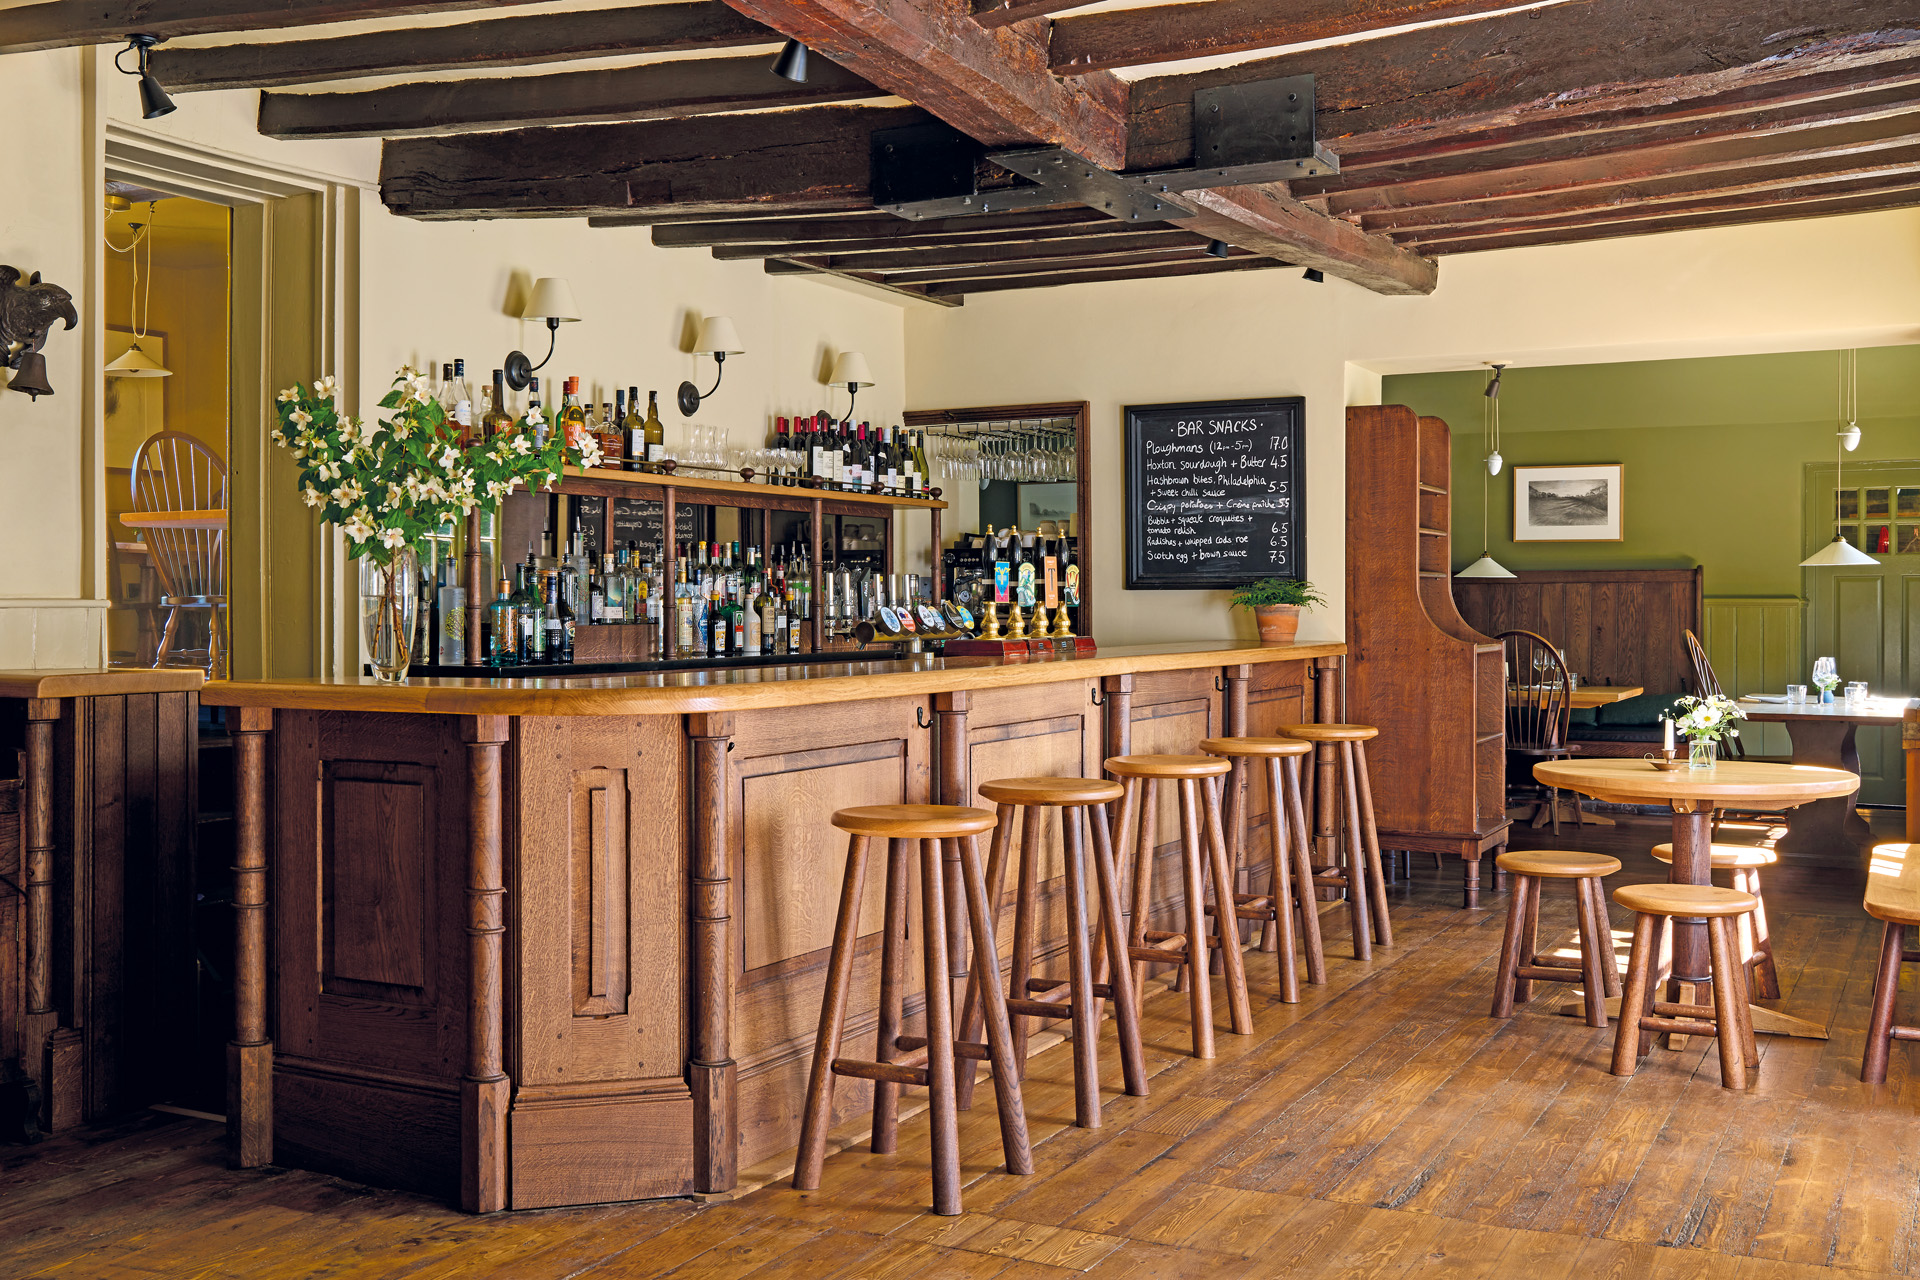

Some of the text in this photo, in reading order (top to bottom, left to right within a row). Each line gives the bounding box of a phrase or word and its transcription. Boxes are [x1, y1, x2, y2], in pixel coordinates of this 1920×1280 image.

[1177, 418, 1257, 437] BAR SNACKS
[1146, 440, 1204, 456] Ploughmans
[1269, 435, 1288, 451] 17.0
[1146, 458, 1176, 471] Hoxton
[1240, 454, 1267, 469] Butter
[1270, 454, 1288, 469] 4.5
[1146, 474, 1190, 486] Hashbrown
[1217, 473, 1267, 488] Philadelphia
[1267, 480, 1288, 493] 5.5
[1146, 499, 1176, 515] Crispy
[1180, 498, 1214, 513] potatoes
[1174, 527, 1196, 535] relish
[1271, 521, 1288, 534] 6.5
[1178, 514, 1204, 527] squeak
[1146, 536, 1177, 547] Radishes
[1184, 536, 1212, 547] whipped
[1270, 536, 1288, 547] 6.5
[1146, 550, 1175, 561] Scotch
[1175, 553, 1189, 564] egg
[1199, 549, 1221, 560] brown
[1222, 550, 1248, 558] sauce
[1268, 550, 1286, 564] 7.5
